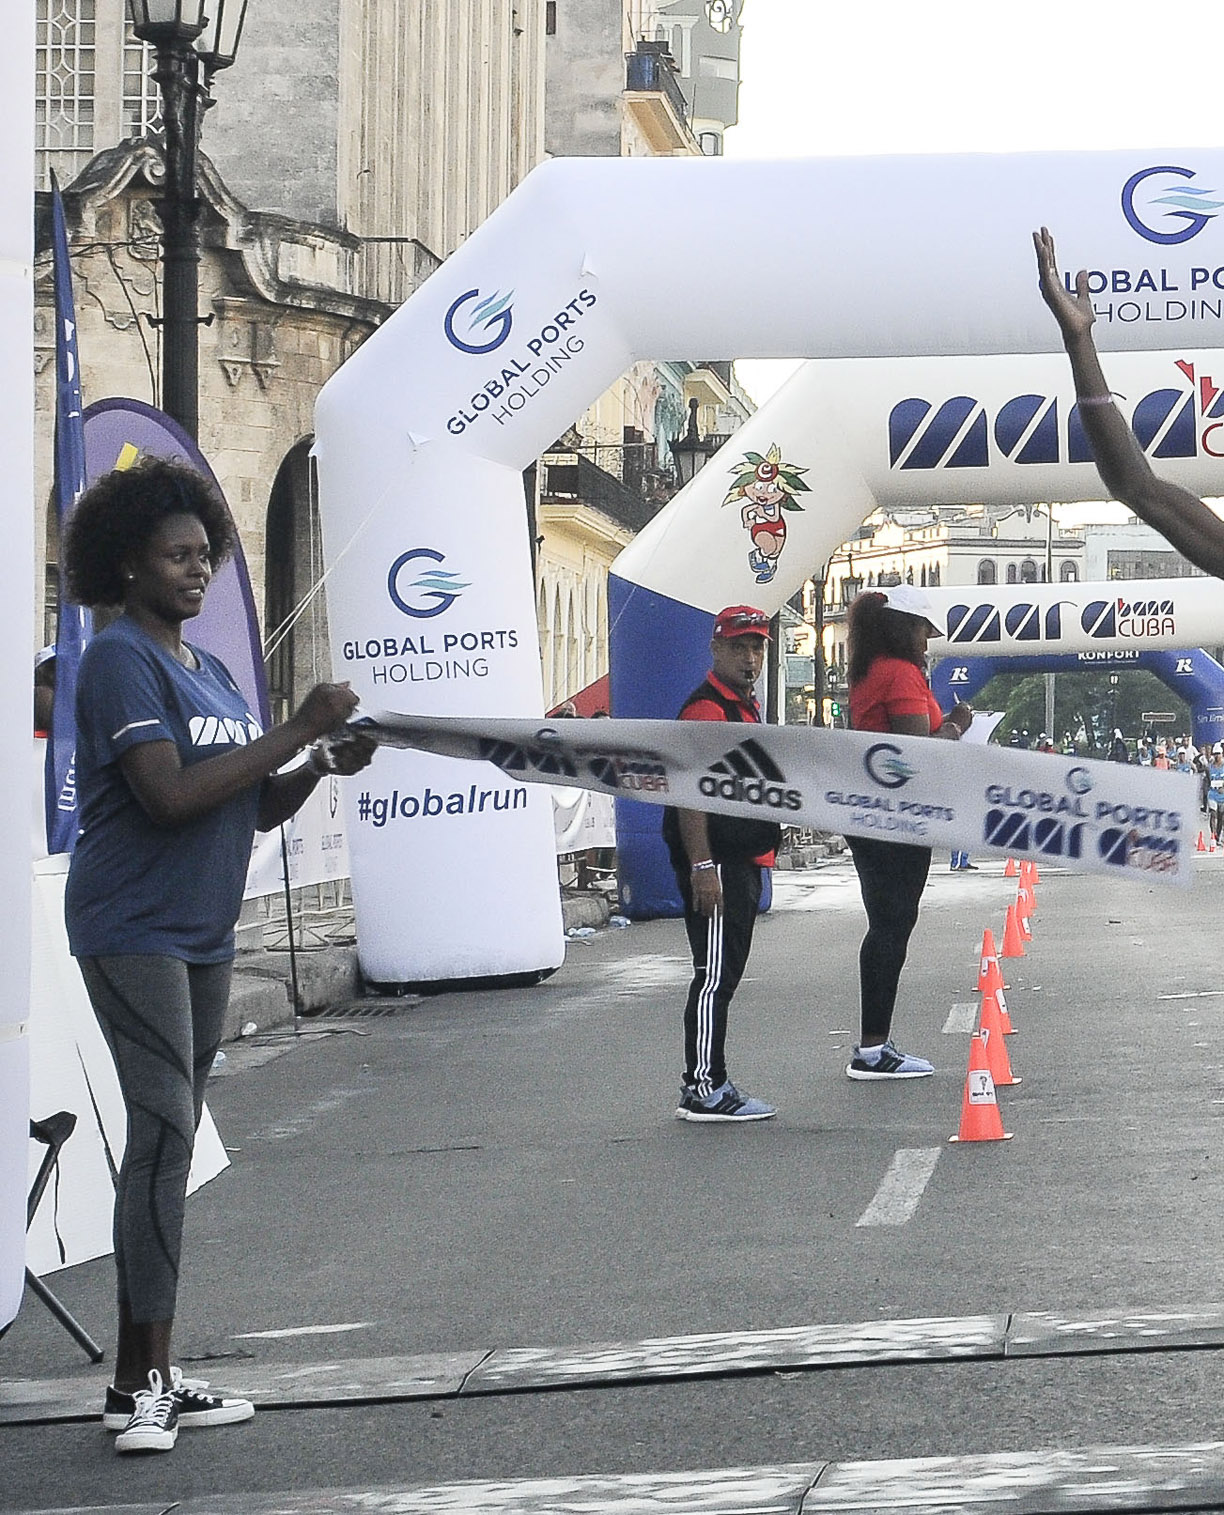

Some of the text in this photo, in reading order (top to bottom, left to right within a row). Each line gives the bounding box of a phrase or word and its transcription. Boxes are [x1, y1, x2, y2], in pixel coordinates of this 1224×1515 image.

[1039, 268, 1179, 296] LOBAL
[447, 289, 597, 435] GLOBAL PORTS
[491, 335, 585, 425] HOLDING
[1118, 618, 1175, 636] CUBA
[343, 630, 518, 661] GLOBAL PORTS
[373, 658, 489, 684] HOLDING
[357, 784, 528, 828] #globalrun
[699, 775, 801, 811] adidas
[824, 791, 955, 821] GLOBAL PORTS
[984, 785, 1181, 832] GLOBAL PORTS
